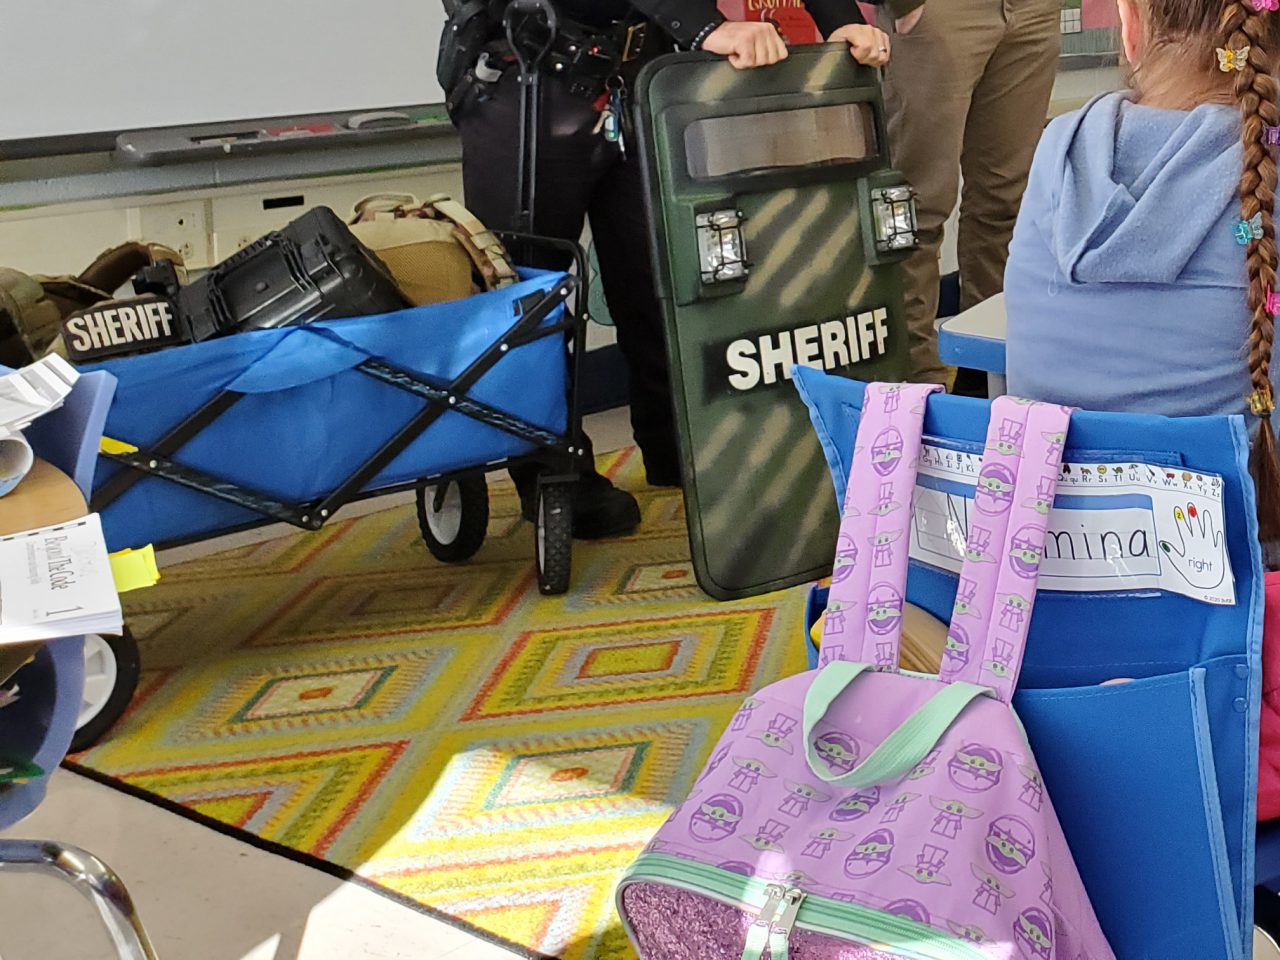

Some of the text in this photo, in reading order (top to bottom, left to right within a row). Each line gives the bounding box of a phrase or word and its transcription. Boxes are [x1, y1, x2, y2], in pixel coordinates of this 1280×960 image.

[66, 301, 173, 352] SHERIFF
[726, 307, 889, 391] SHERIFF
[934, 457, 943, 467] Hh
[1081, 474, 1092, 483] Rr
[1098, 474, 1108, 483] Ss
[1129, 473, 1141, 482] Uu
[1146, 474, 1158, 484] Vv
[1162, 478, 1178, 487] Ww
[1197, 483, 1208, 496] Yy
[1211, 488, 1221, 498] Zz
[49, 570, 76, 590] Code
[1188, 557, 1213, 573] right
